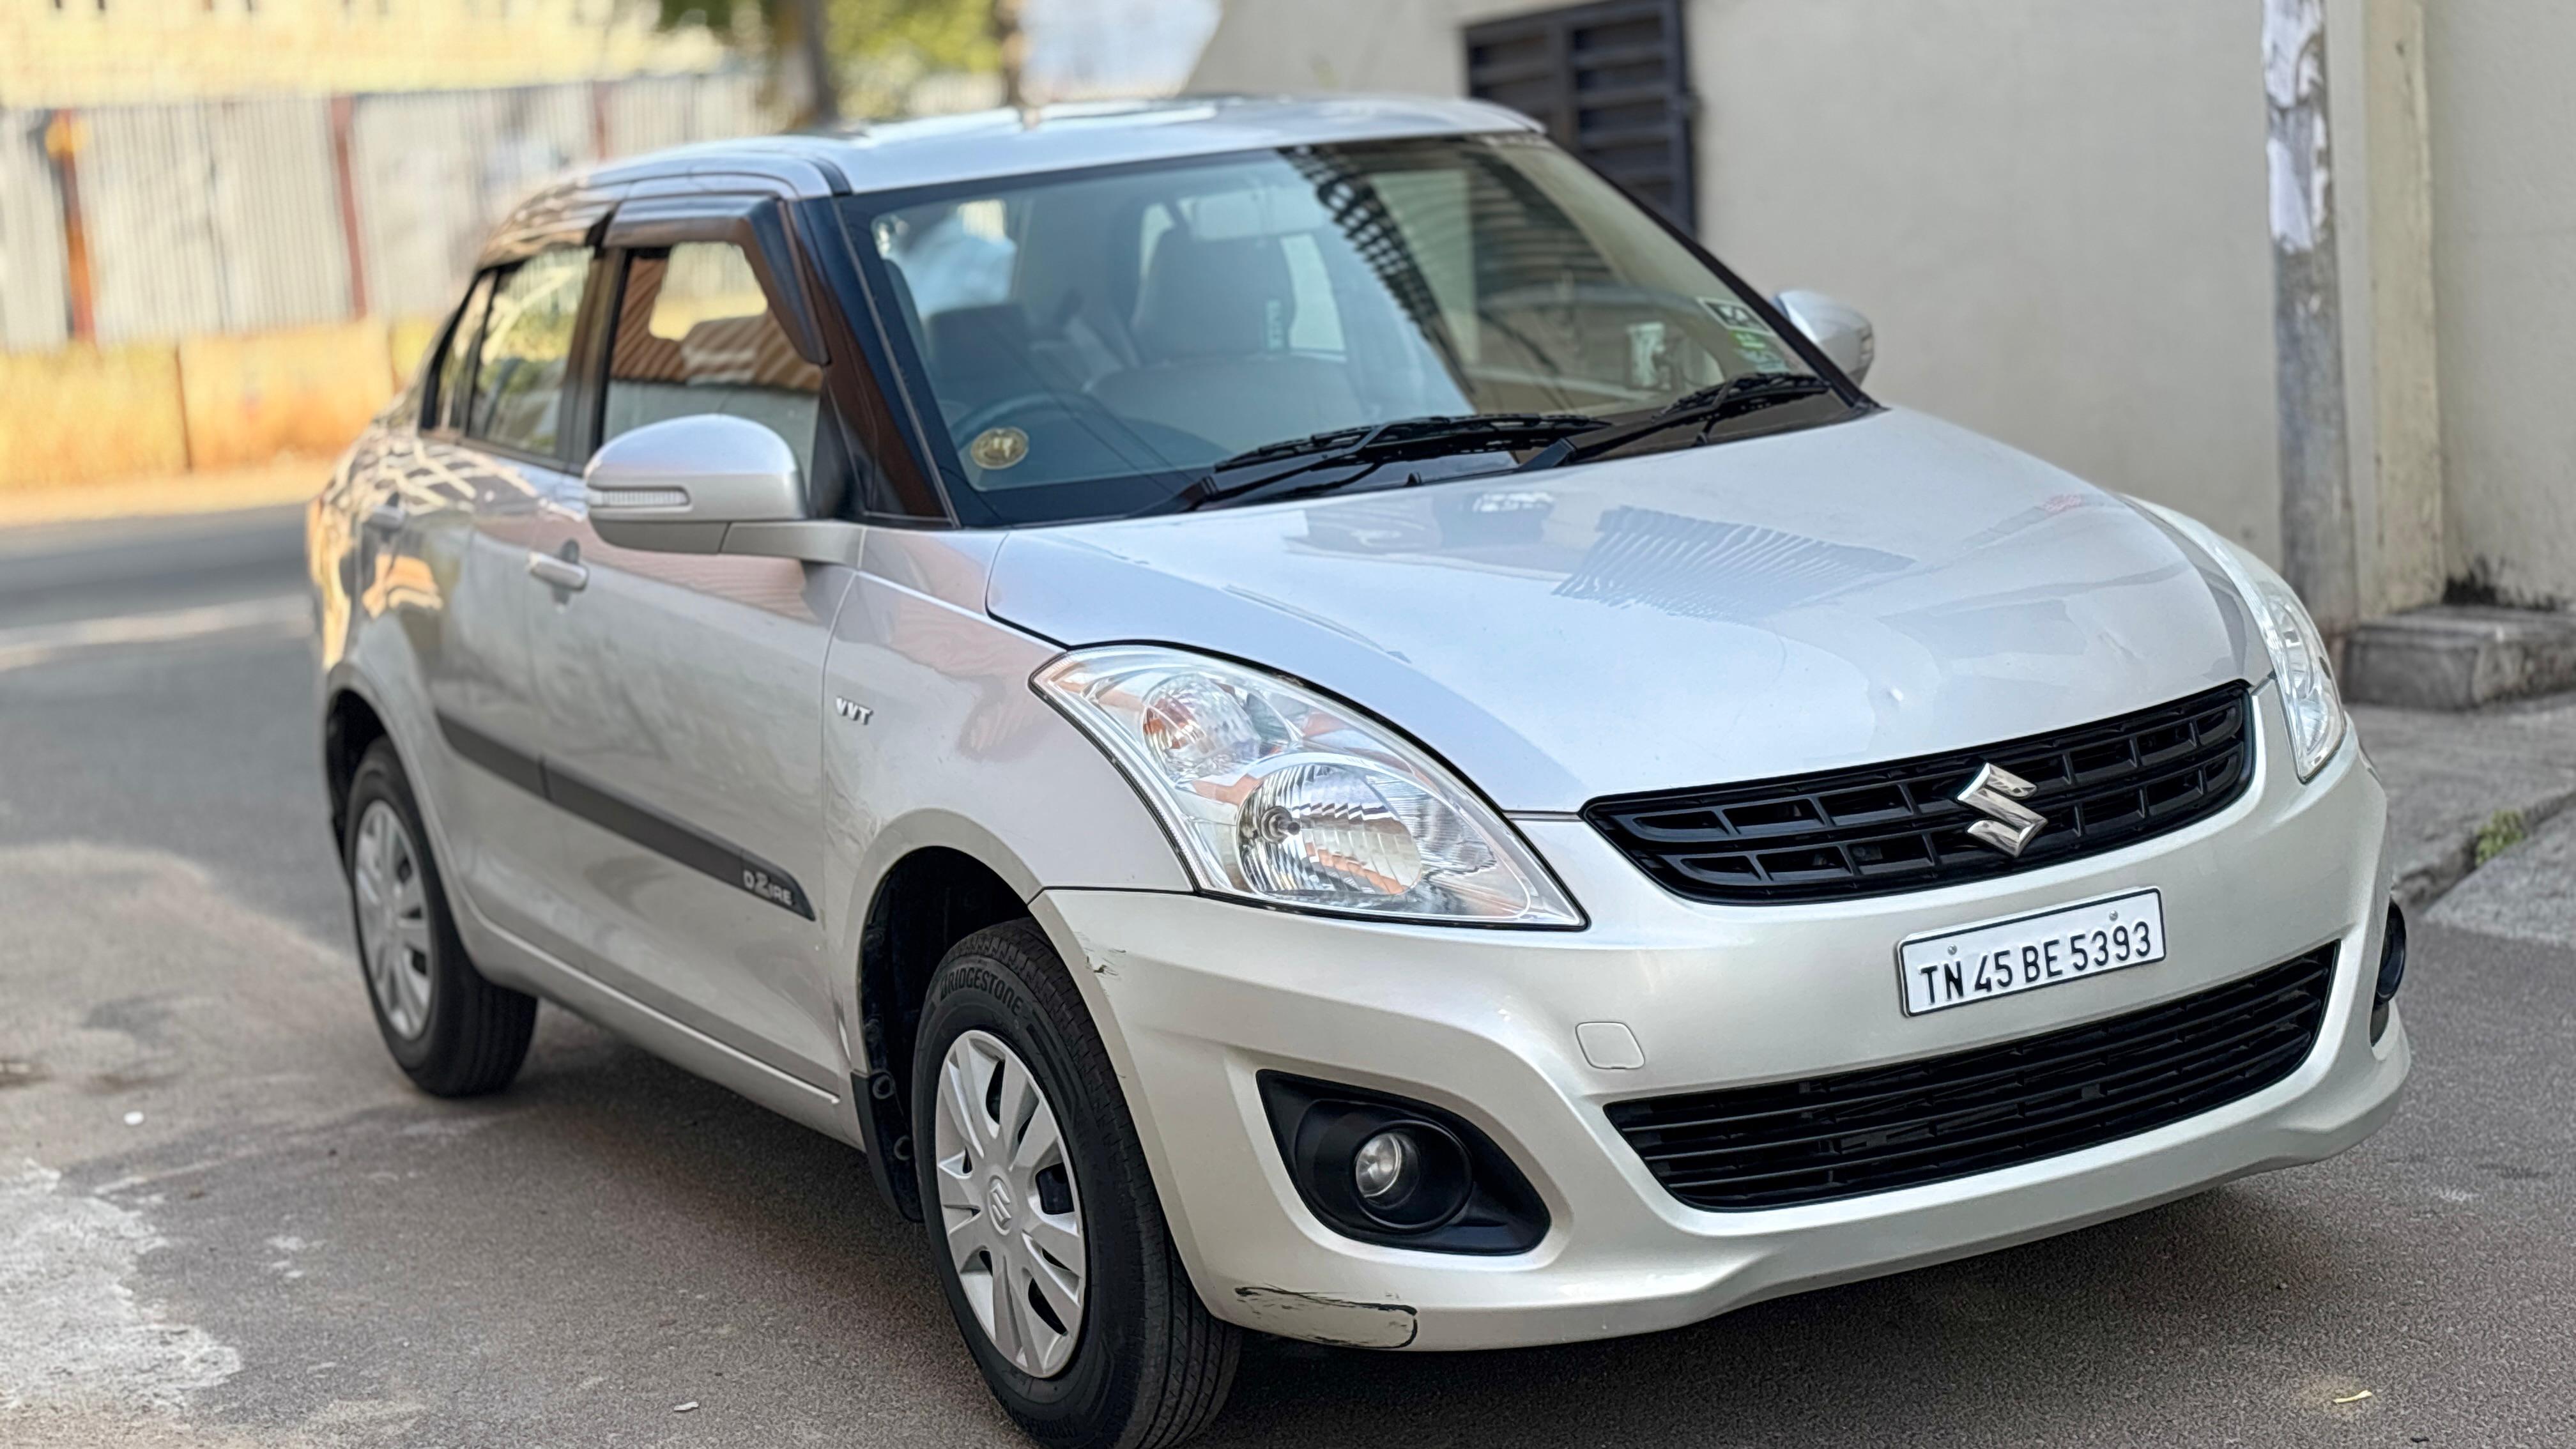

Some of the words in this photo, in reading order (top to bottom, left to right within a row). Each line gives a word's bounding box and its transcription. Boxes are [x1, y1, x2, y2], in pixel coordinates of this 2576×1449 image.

[836, 697, 874, 726] VVT
[1920, 960, 1965, 1004] TN
[1974, 949, 2013, 993] 45
[2022, 939, 2063, 984] BE
[2069, 921, 2151, 971] 5393
[939, 967, 1023, 1016] BRIDGESTONE
